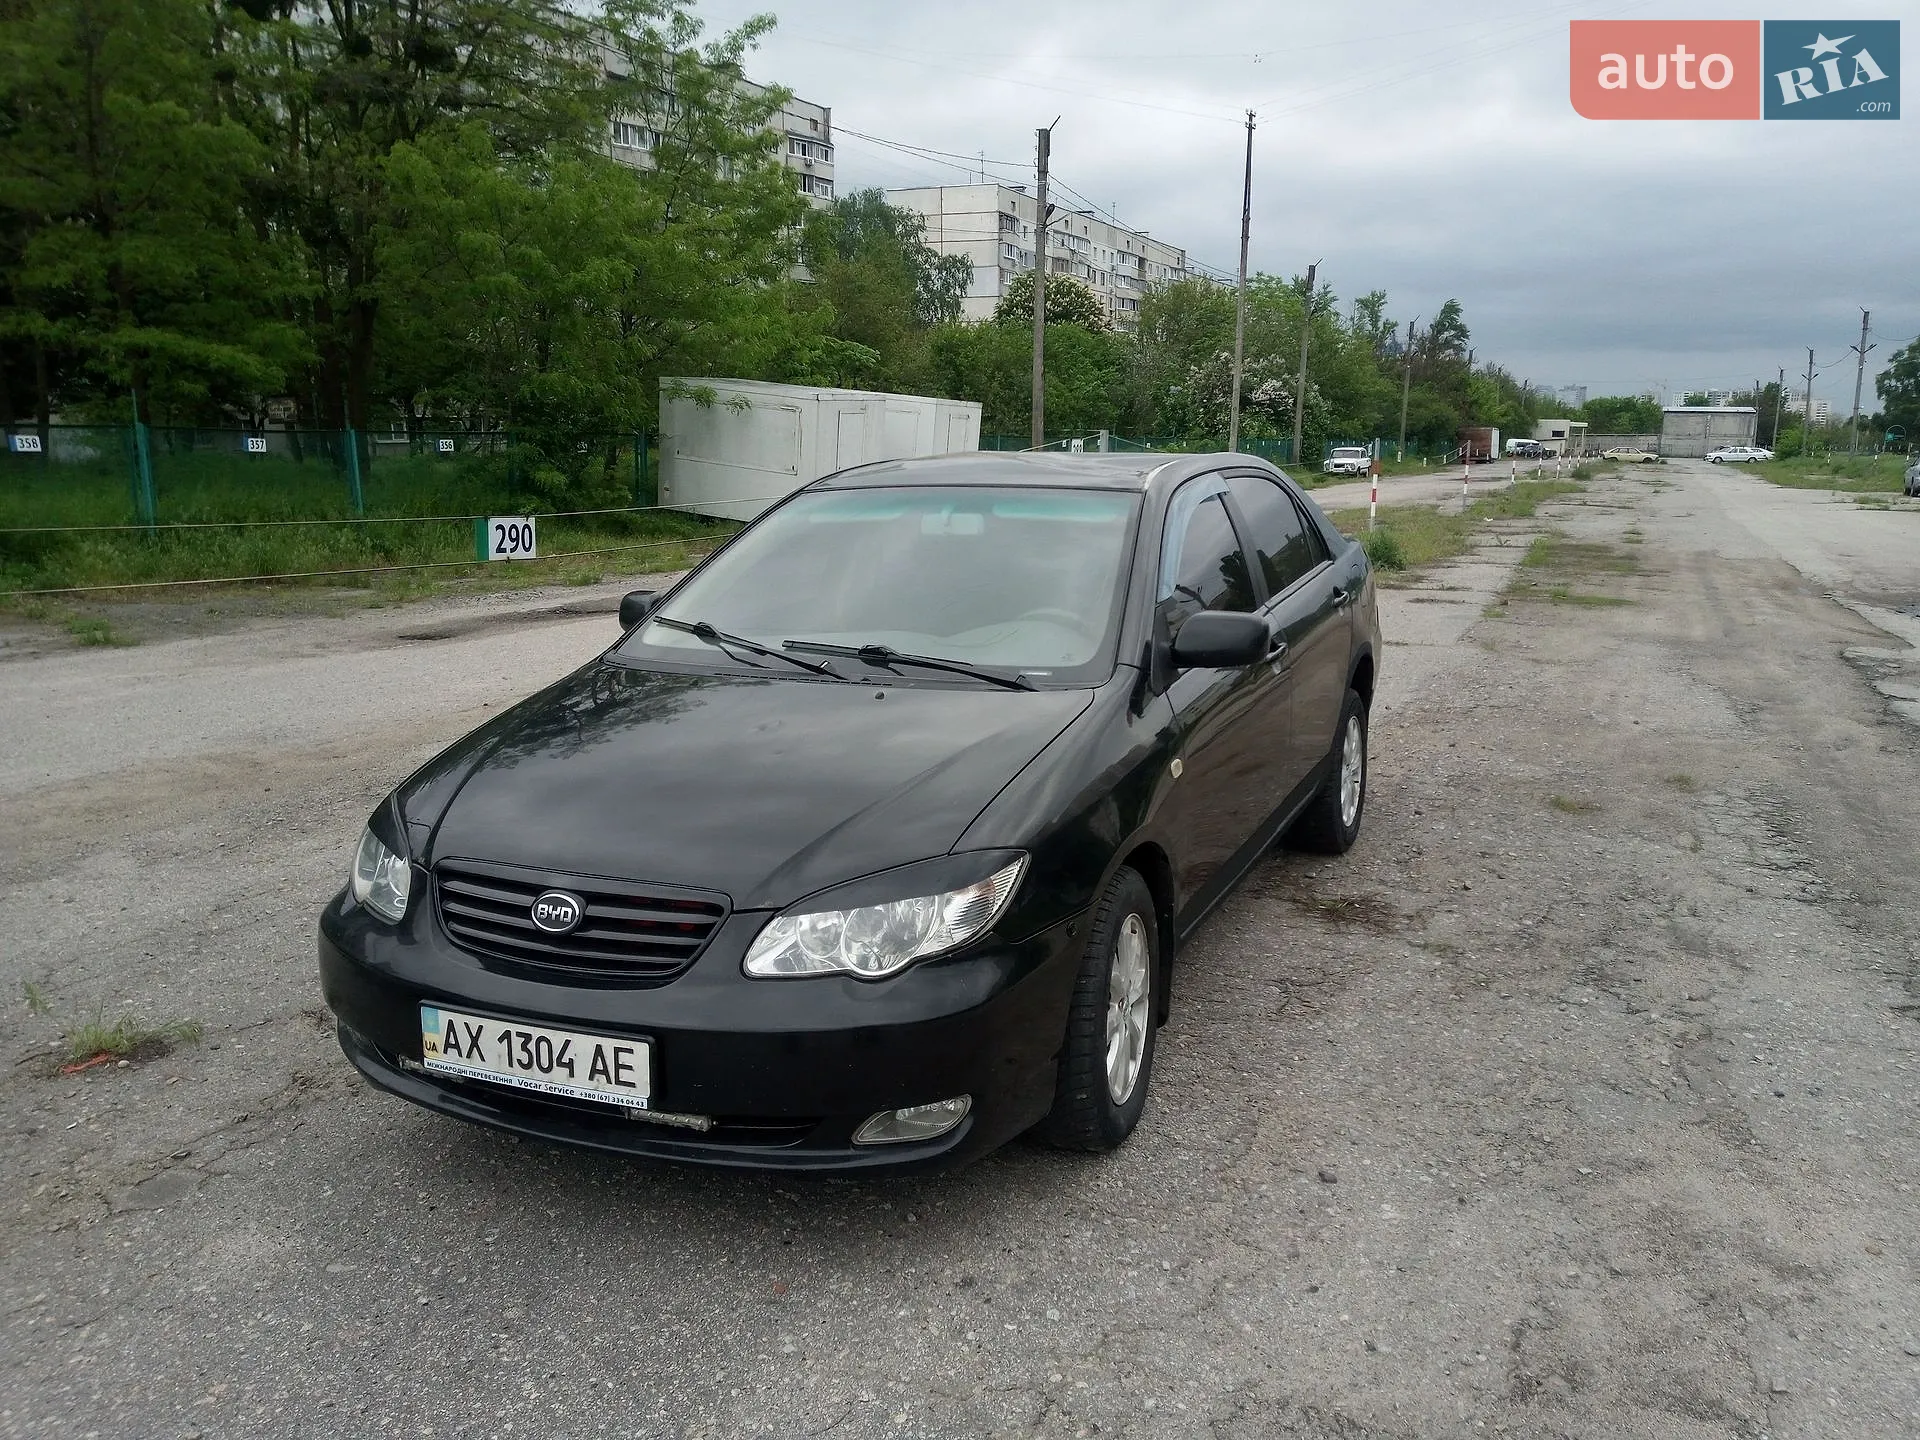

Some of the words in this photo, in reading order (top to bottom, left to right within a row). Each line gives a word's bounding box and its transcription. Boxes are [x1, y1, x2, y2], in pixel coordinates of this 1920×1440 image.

[17, 438, 38, 449] 358
[250, 439, 264, 450] 357
[495, 523, 533, 553] 290
[536, 903, 573, 922] BYD
[425, 1041, 438, 1053] UA
[443, 1019, 485, 1062] AX
[497, 1029, 575, 1078] 1304
[588, 1044, 636, 1088] AE
[517, 1079, 542, 1090] Vocar
[544, 1082, 575, 1096] Service
[580, 1091, 596, 1100] +380
